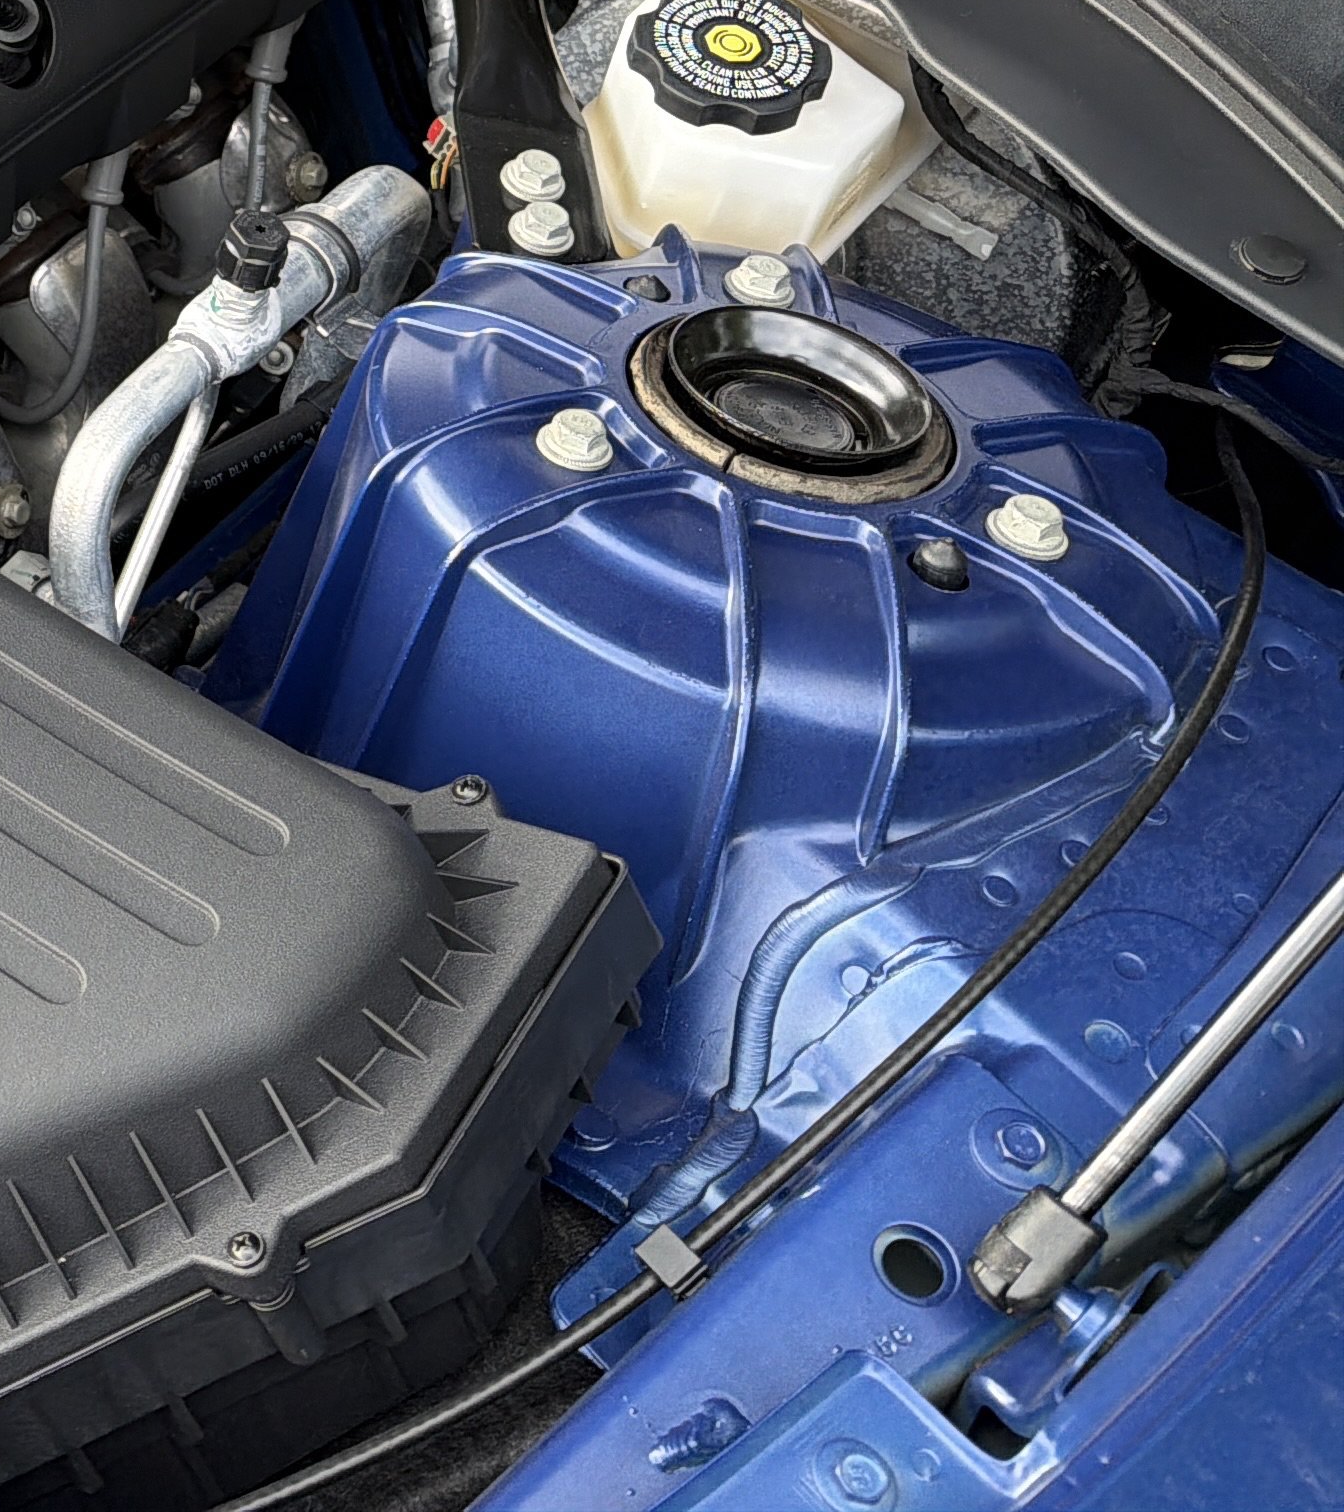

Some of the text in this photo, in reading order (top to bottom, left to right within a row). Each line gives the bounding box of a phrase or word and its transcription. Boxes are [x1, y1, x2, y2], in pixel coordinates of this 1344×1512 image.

[721, 0, 739, 9] QUE
[743, 2, 756, 14] DU
[763, 2, 802, 30] BOUCHON
[668, 37, 691, 63] BEFORE
[735, 78, 754, 88] USE
[753, 75, 779, 88] ONLY
[701, 60, 732, 78] CLEAN
[734, 67, 768, 79] FILLER
[664, 56, 690, 77] FROM
[684, 73, 694, 82] A
[693, 77, 730, 97] SEALED
[203, 472, 223, 491] DOT
